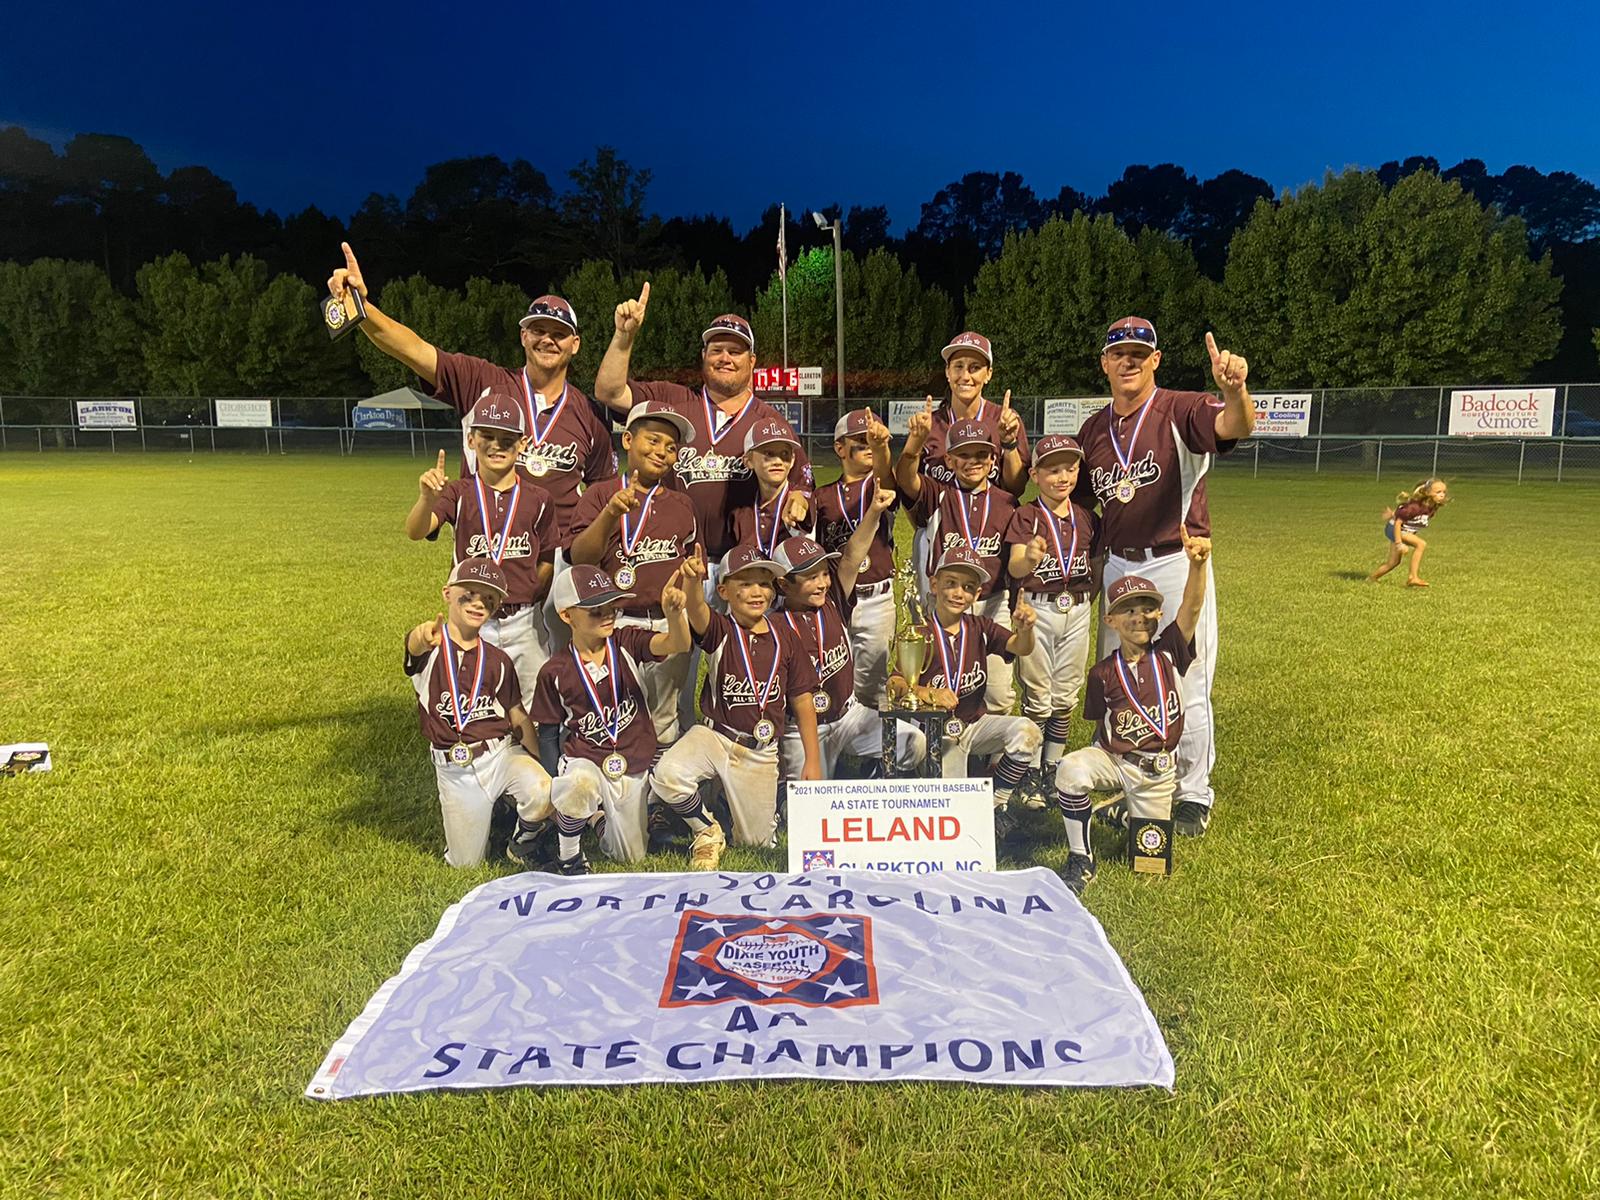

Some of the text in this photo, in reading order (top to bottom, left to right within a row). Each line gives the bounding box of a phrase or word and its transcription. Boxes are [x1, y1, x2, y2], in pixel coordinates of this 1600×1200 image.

[799, 372, 821, 380] CLARKTON
[804, 383, 816, 391] DRUG
[1252, 396, 1307, 410] pe Fear
[1461, 393, 1539, 412] Badcock
[489, 404, 501, 420] L
[1477, 412, 1538, 429] &more
[770, 422, 782, 436] L
[966, 424, 977, 437] L
[1051, 437, 1063, 448] L
[803, 541, 817, 554] L
[964, 551, 974, 563] L
[479, 564, 491, 579] L
[594, 573, 609, 588] L
[1126, 579, 1139, 593] L
[794, 783, 986, 796] 2021 NORTH CAROLINA DIXIE YOUTH BASEBALL
[830, 798, 951, 810] AA STATE TOURNAMENT
[821, 816, 961, 843] LELAND
[498, 889, 1054, 916] NORTH CAROLINA
[723, 944, 820, 961] DIXIE YOUTH
[725, 1005, 808, 1033] AA
[423, 1040, 640, 1078] STATE
[666, 1038, 1087, 1073] CHAMPIONS
